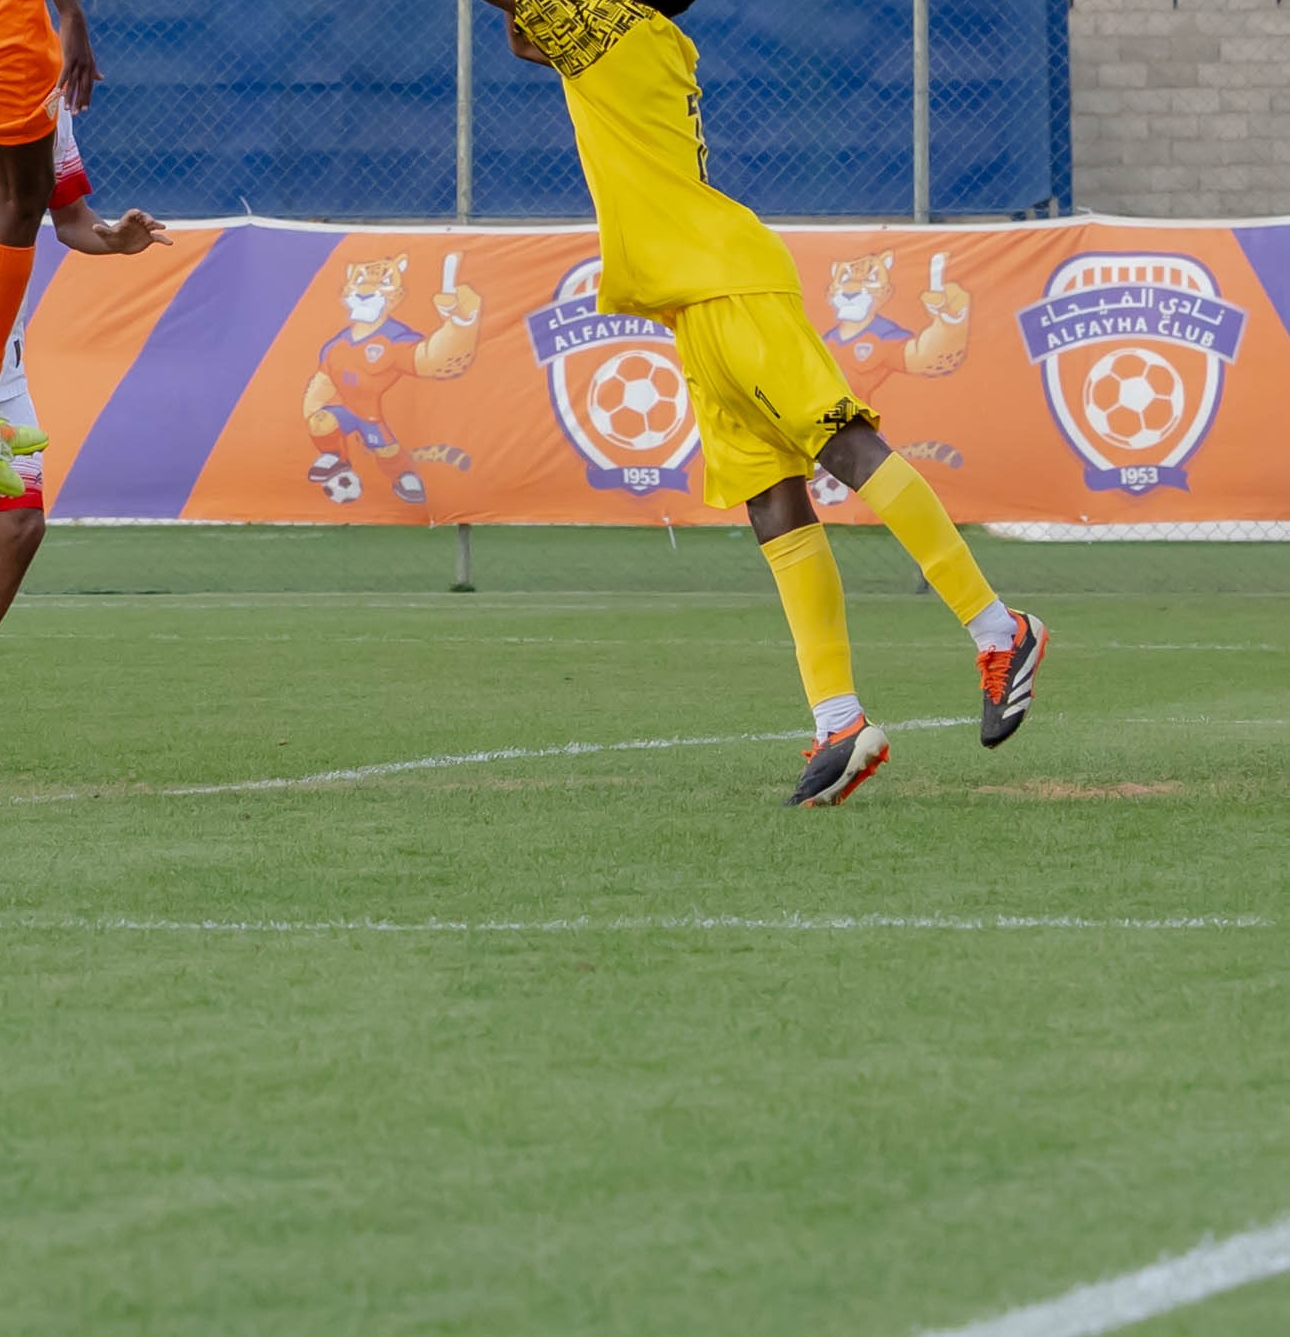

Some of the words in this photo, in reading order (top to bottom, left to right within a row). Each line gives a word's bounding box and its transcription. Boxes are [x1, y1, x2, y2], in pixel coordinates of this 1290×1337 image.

[1041, 288, 1153, 327] الفيحاء
[1159, 298, 1225, 326] نادي
[554, 319, 655, 351] ALFAYHA
[1047, 317, 1148, 349] ALFAYHA
[1157, 319, 1216, 348] CLUB
[623, 467, 660, 486] 1953
[1121, 466, 1159, 485] 1953
